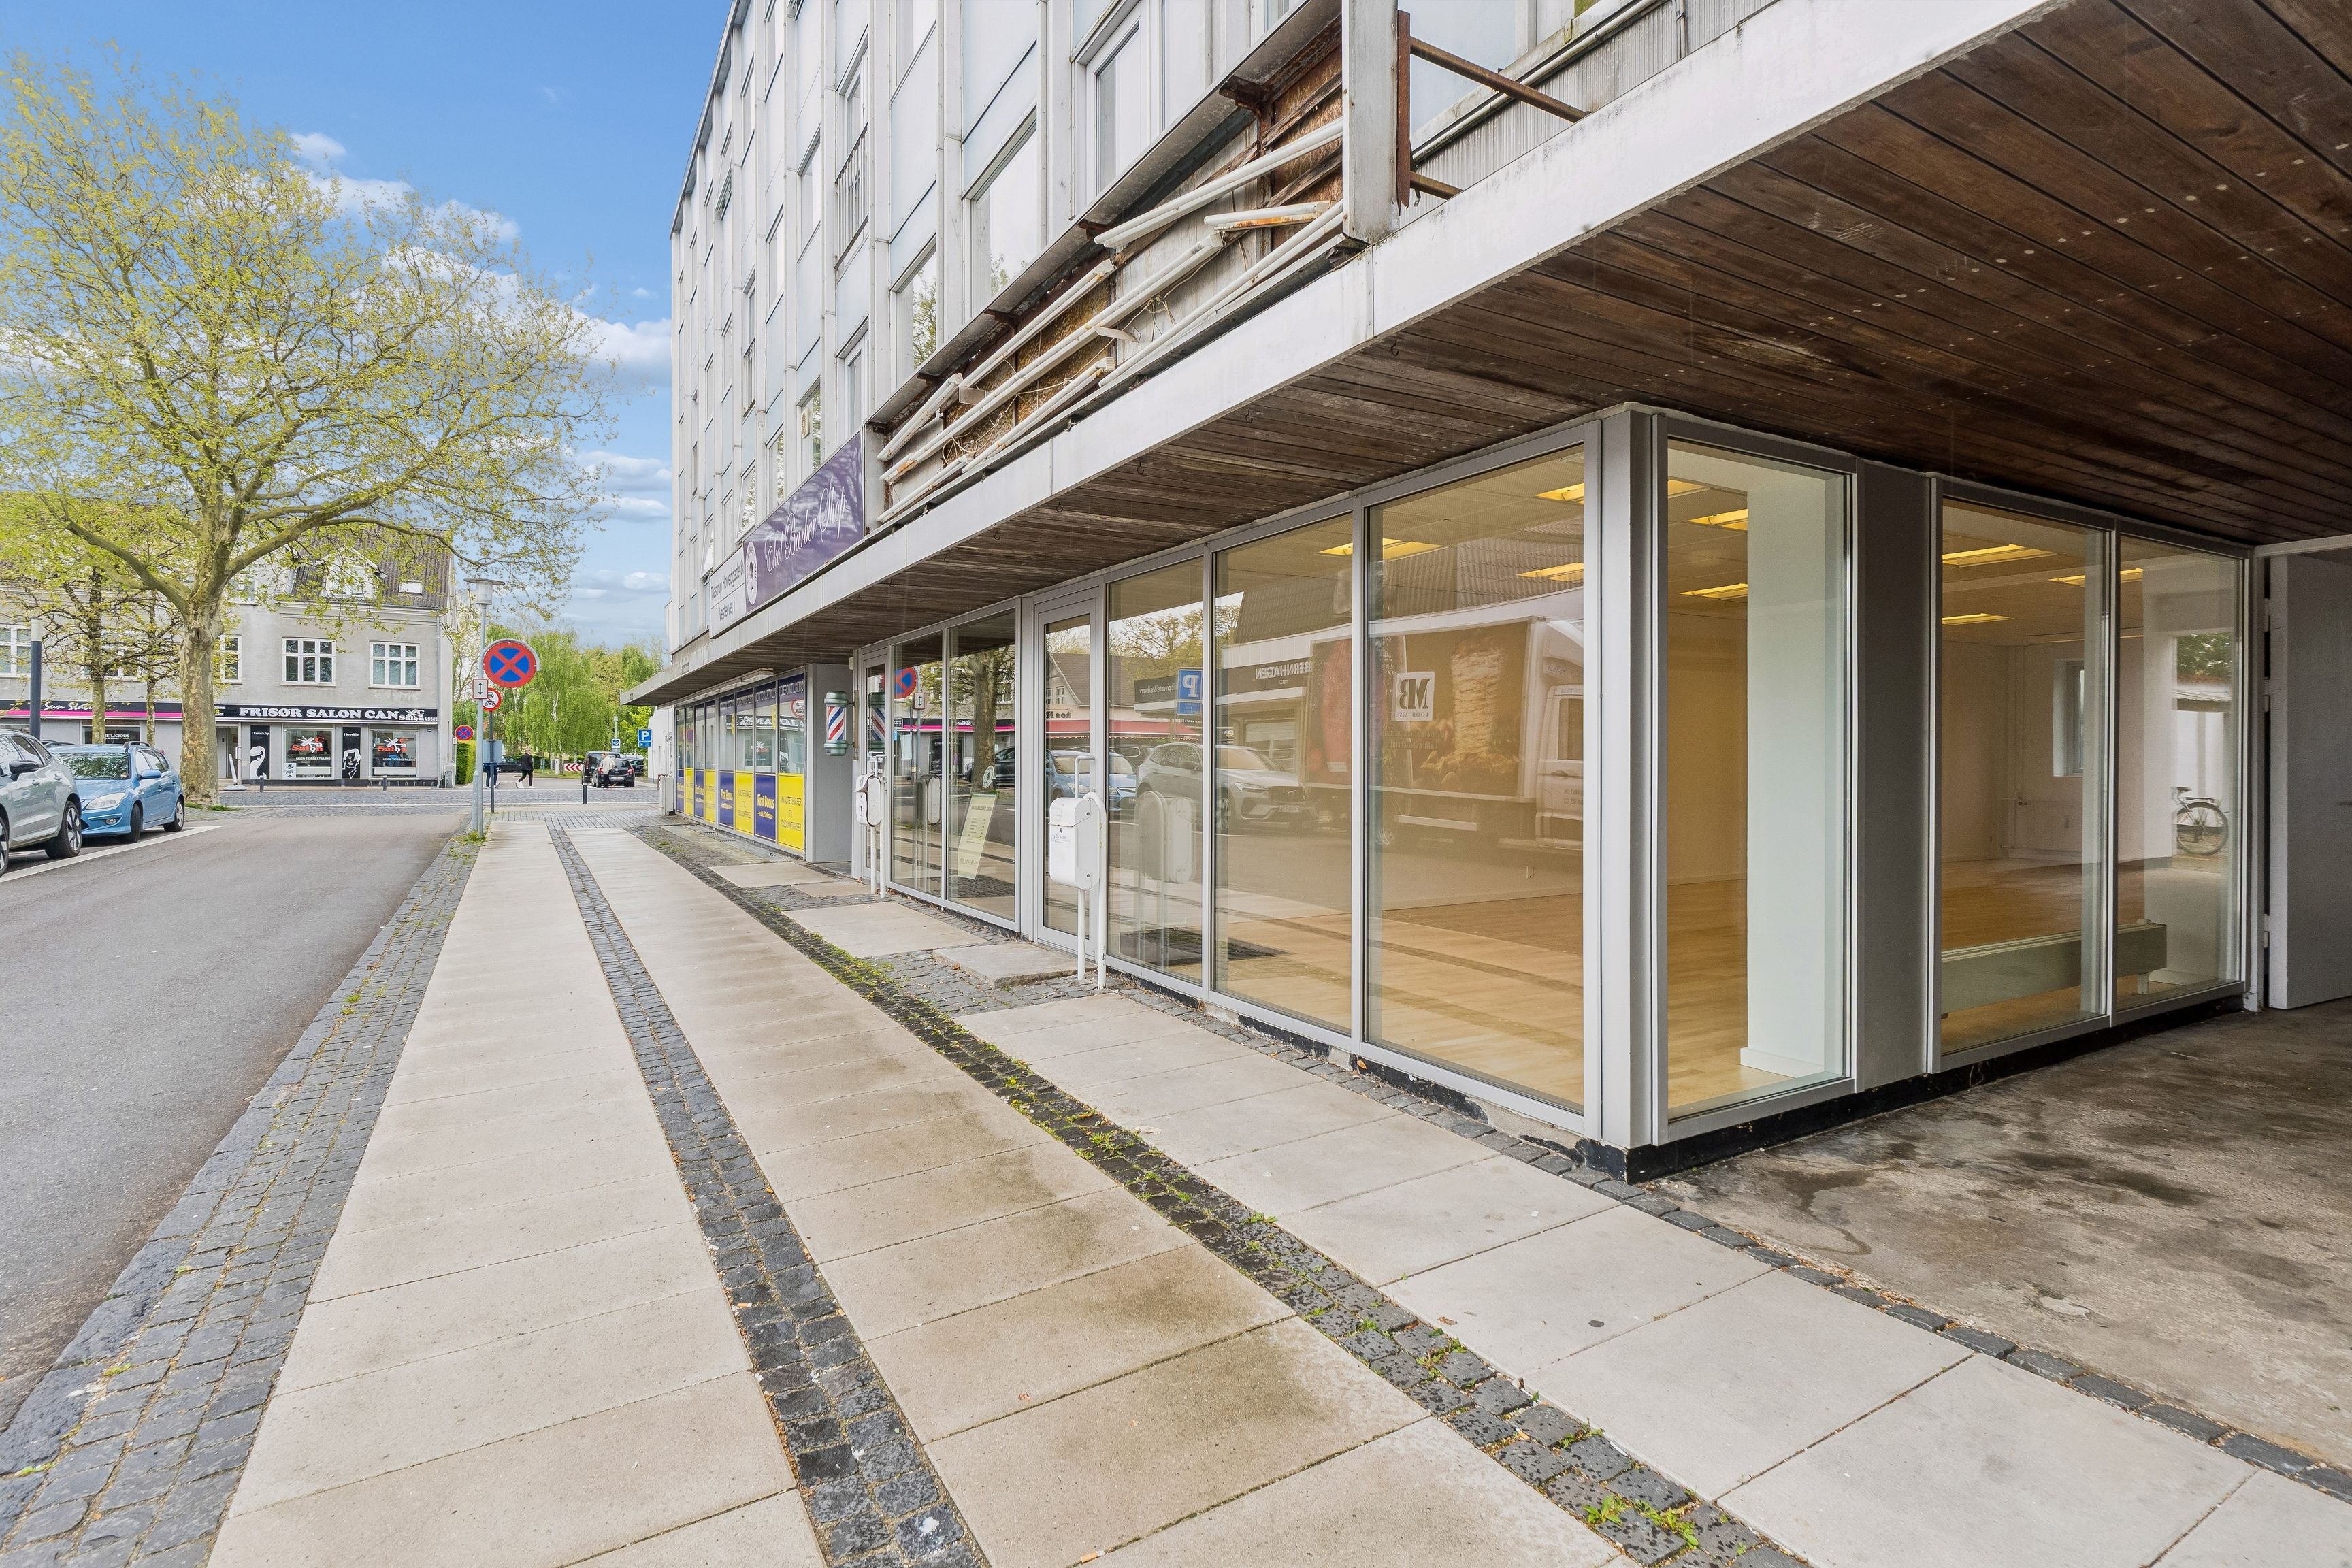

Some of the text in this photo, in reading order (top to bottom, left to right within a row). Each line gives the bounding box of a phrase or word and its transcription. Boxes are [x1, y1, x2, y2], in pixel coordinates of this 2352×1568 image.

[785, 509, 817, 559] Barber
[819, 476, 846, 542] Shop
[723, 562, 740, 588] Hovedgade
[719, 597, 733, 621] Vestervej
[44, 702, 65, 711] Sun
[239, 707, 399, 719] FRISØR SALON CAN
[641, 730, 649, 740] P
[764, 795, 774, 808] Bonus
